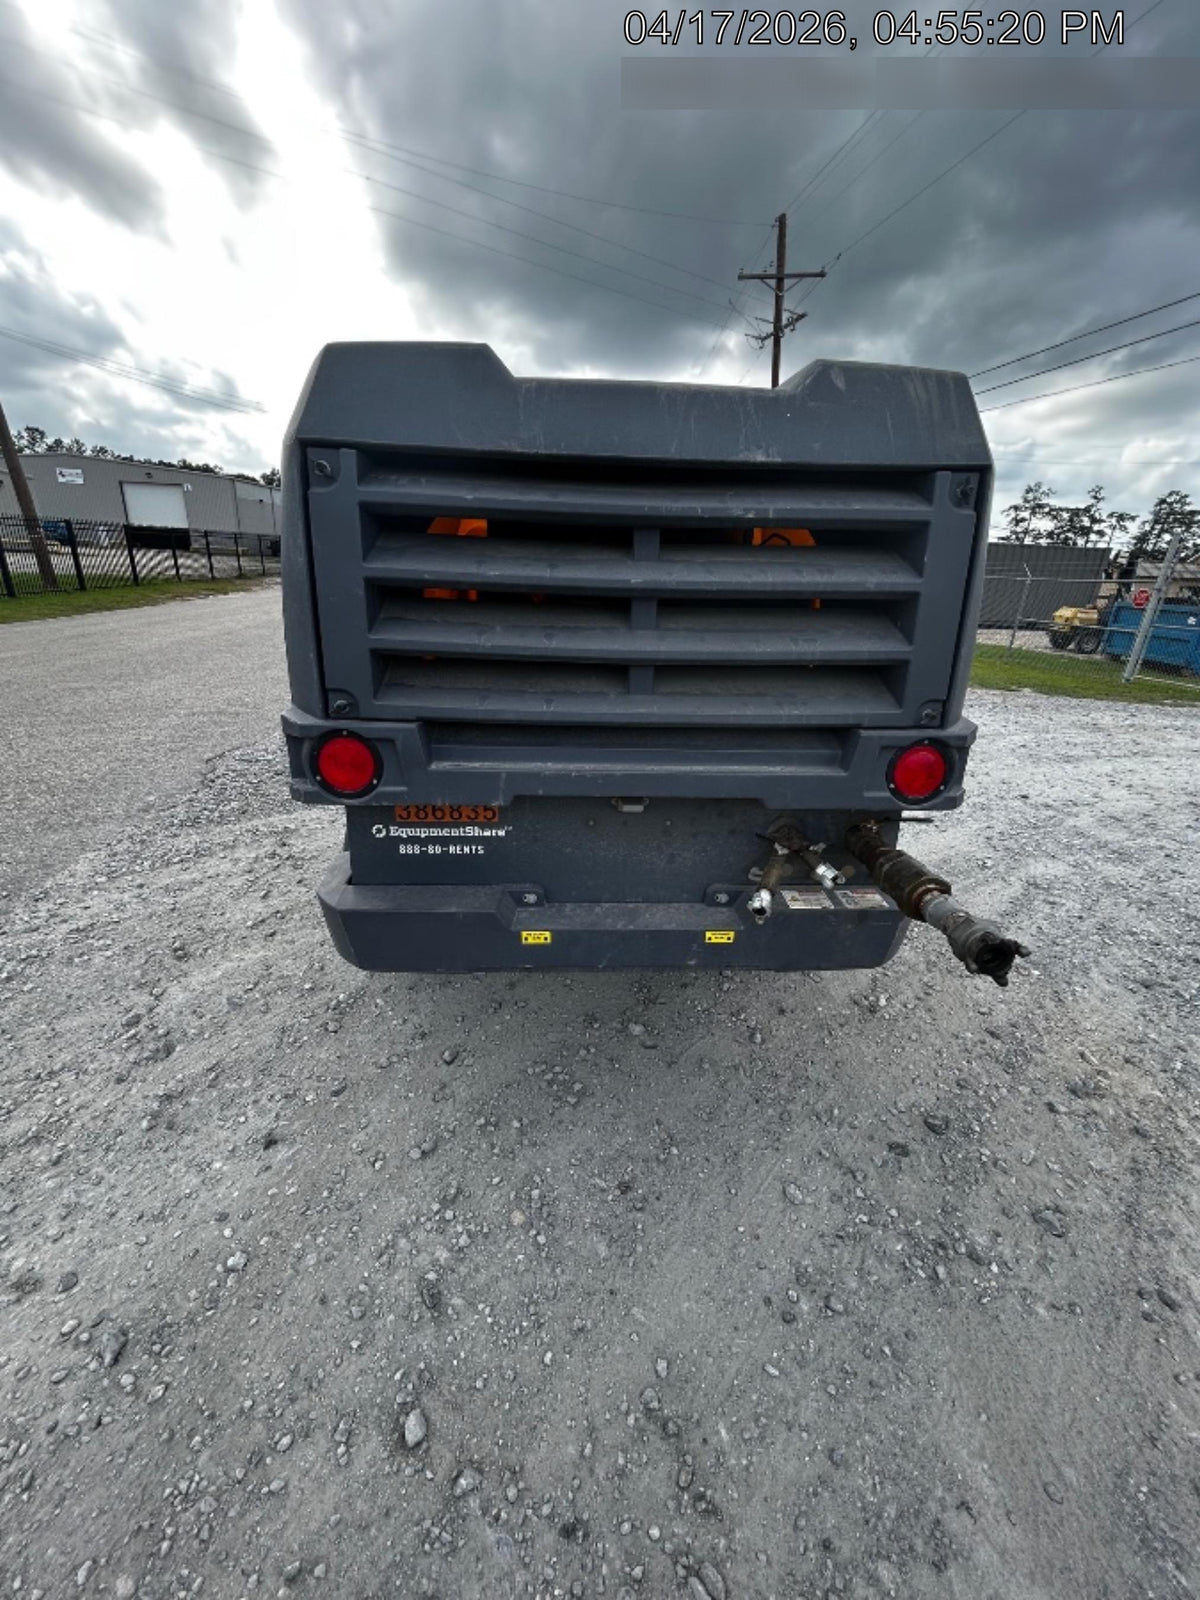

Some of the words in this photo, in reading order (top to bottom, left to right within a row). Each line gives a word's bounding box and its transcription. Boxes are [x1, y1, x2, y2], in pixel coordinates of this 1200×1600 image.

[397, 804, 498, 821] 386835
[388, 824, 507, 838] EquipmentShare
[398, 843, 485, 855] 888-80-RENTS
